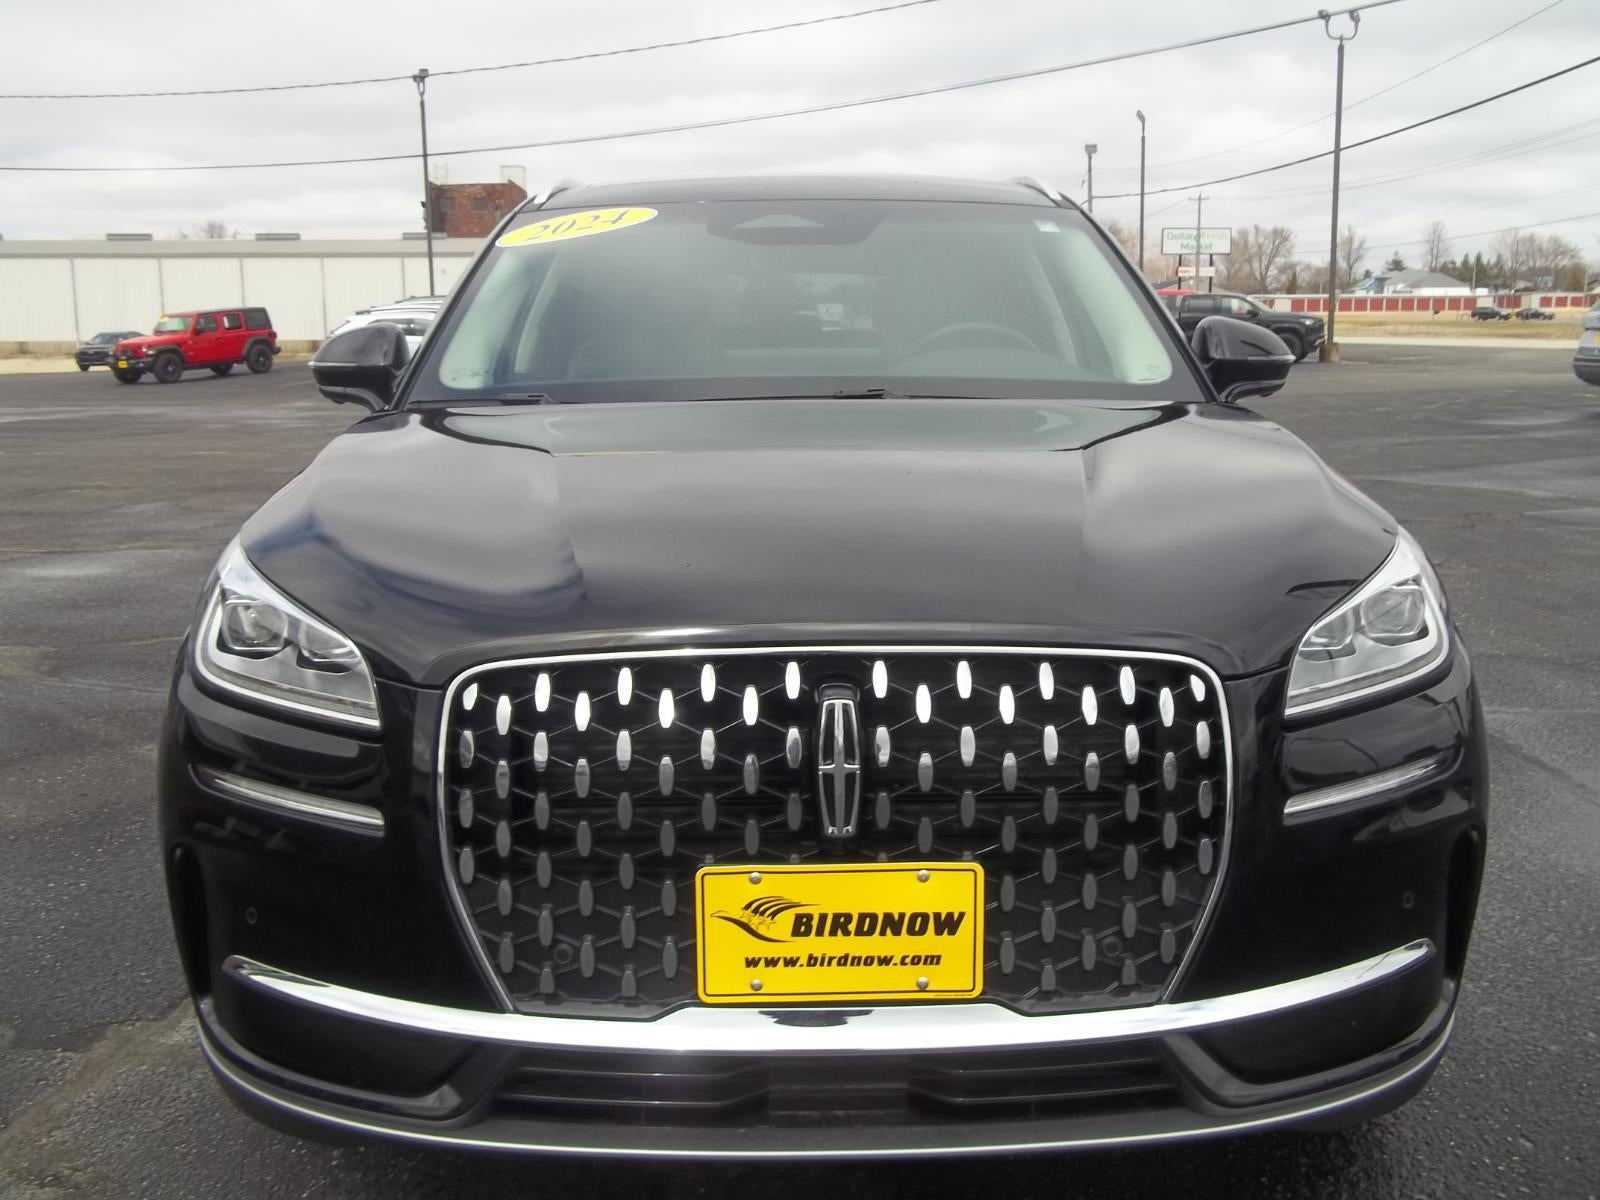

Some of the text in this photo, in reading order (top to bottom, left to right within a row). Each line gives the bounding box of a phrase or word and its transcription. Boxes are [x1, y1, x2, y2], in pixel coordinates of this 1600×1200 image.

[523, 210, 630, 242] 2024
[1180, 241, 1213, 251] Maket
[790, 911, 966, 938] BIRDNOW
[744, 953, 942, 968] www.birdnow.com
